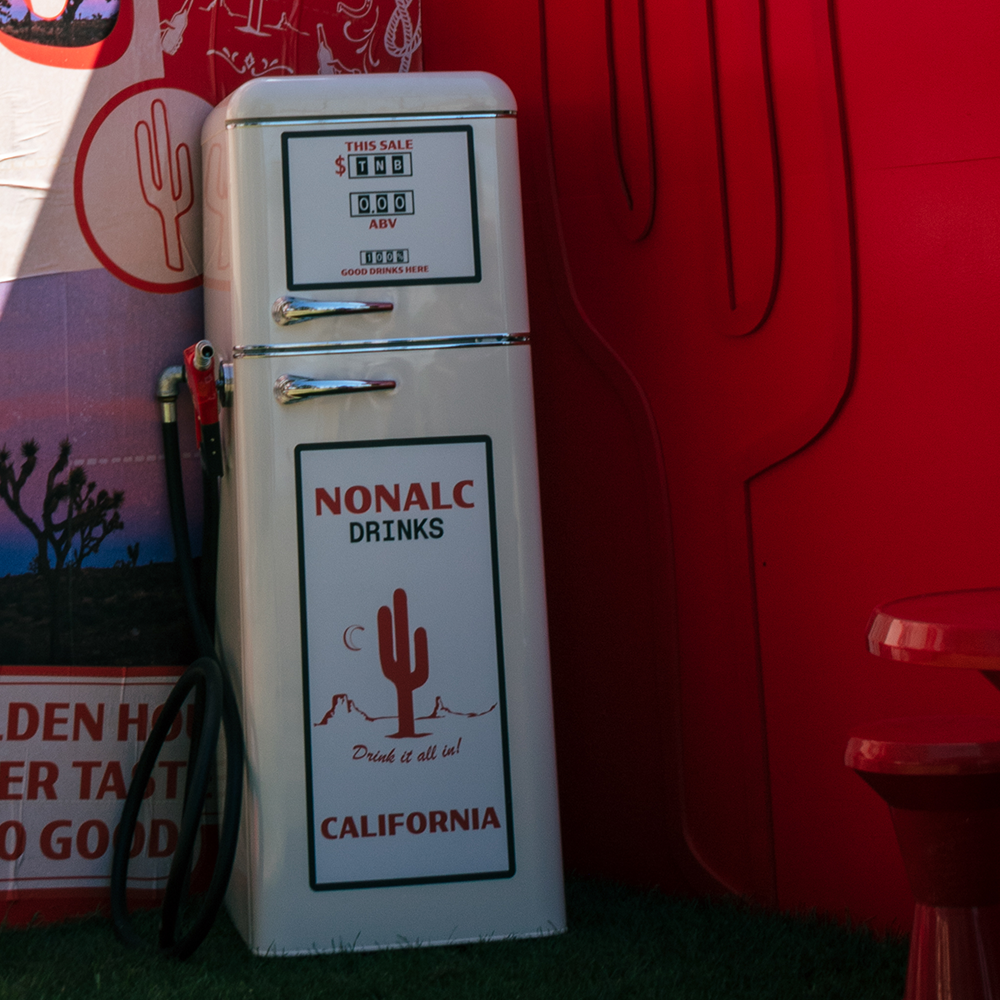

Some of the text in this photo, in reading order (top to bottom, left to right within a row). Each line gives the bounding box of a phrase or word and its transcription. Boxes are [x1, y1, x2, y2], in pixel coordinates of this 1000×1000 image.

[345, 139, 413, 152] THIS SALE
[368, 218, 397, 230] ABV
[341, 265, 429, 276] GOOD DRINKS HERE
[315, 480, 475, 516] NONALC
[349, 517, 444, 543] DRINKS
[352, 737, 462, 763] Drink it all in!
[320, 807, 501, 840] CALIFORNIA
[39, 819, 179, 860] GOOD
